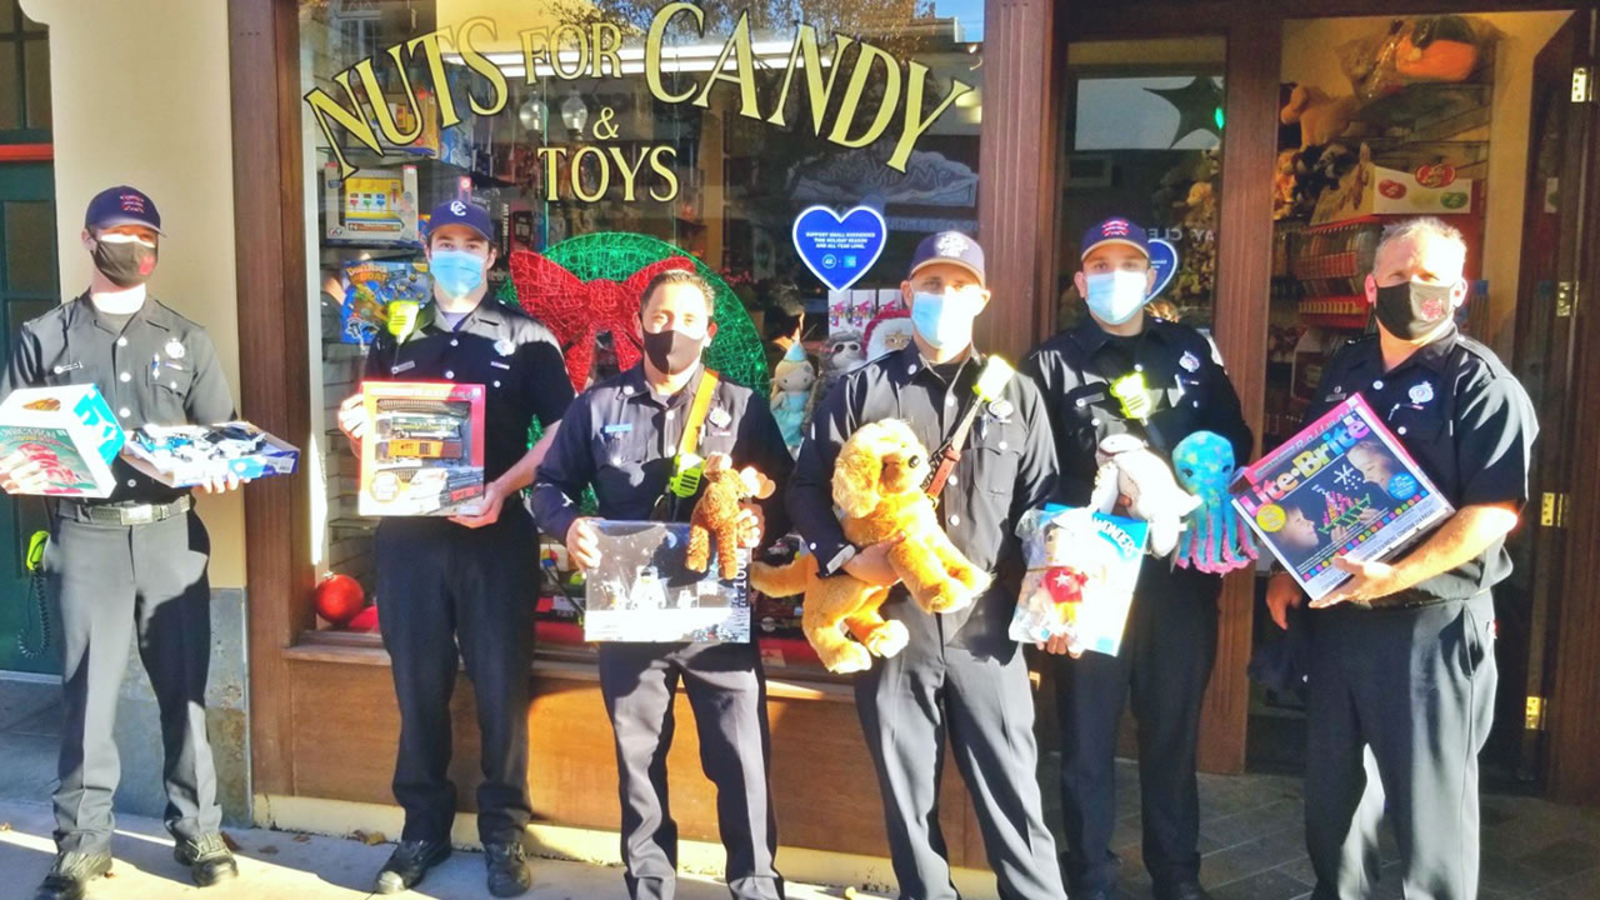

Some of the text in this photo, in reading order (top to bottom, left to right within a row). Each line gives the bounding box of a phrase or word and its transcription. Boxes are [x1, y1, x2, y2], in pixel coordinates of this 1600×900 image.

[304, 1, 974, 181] NUTS FOR CANDY
[593, 106, 620, 141] &
[537, 145, 679, 203] TOYS
